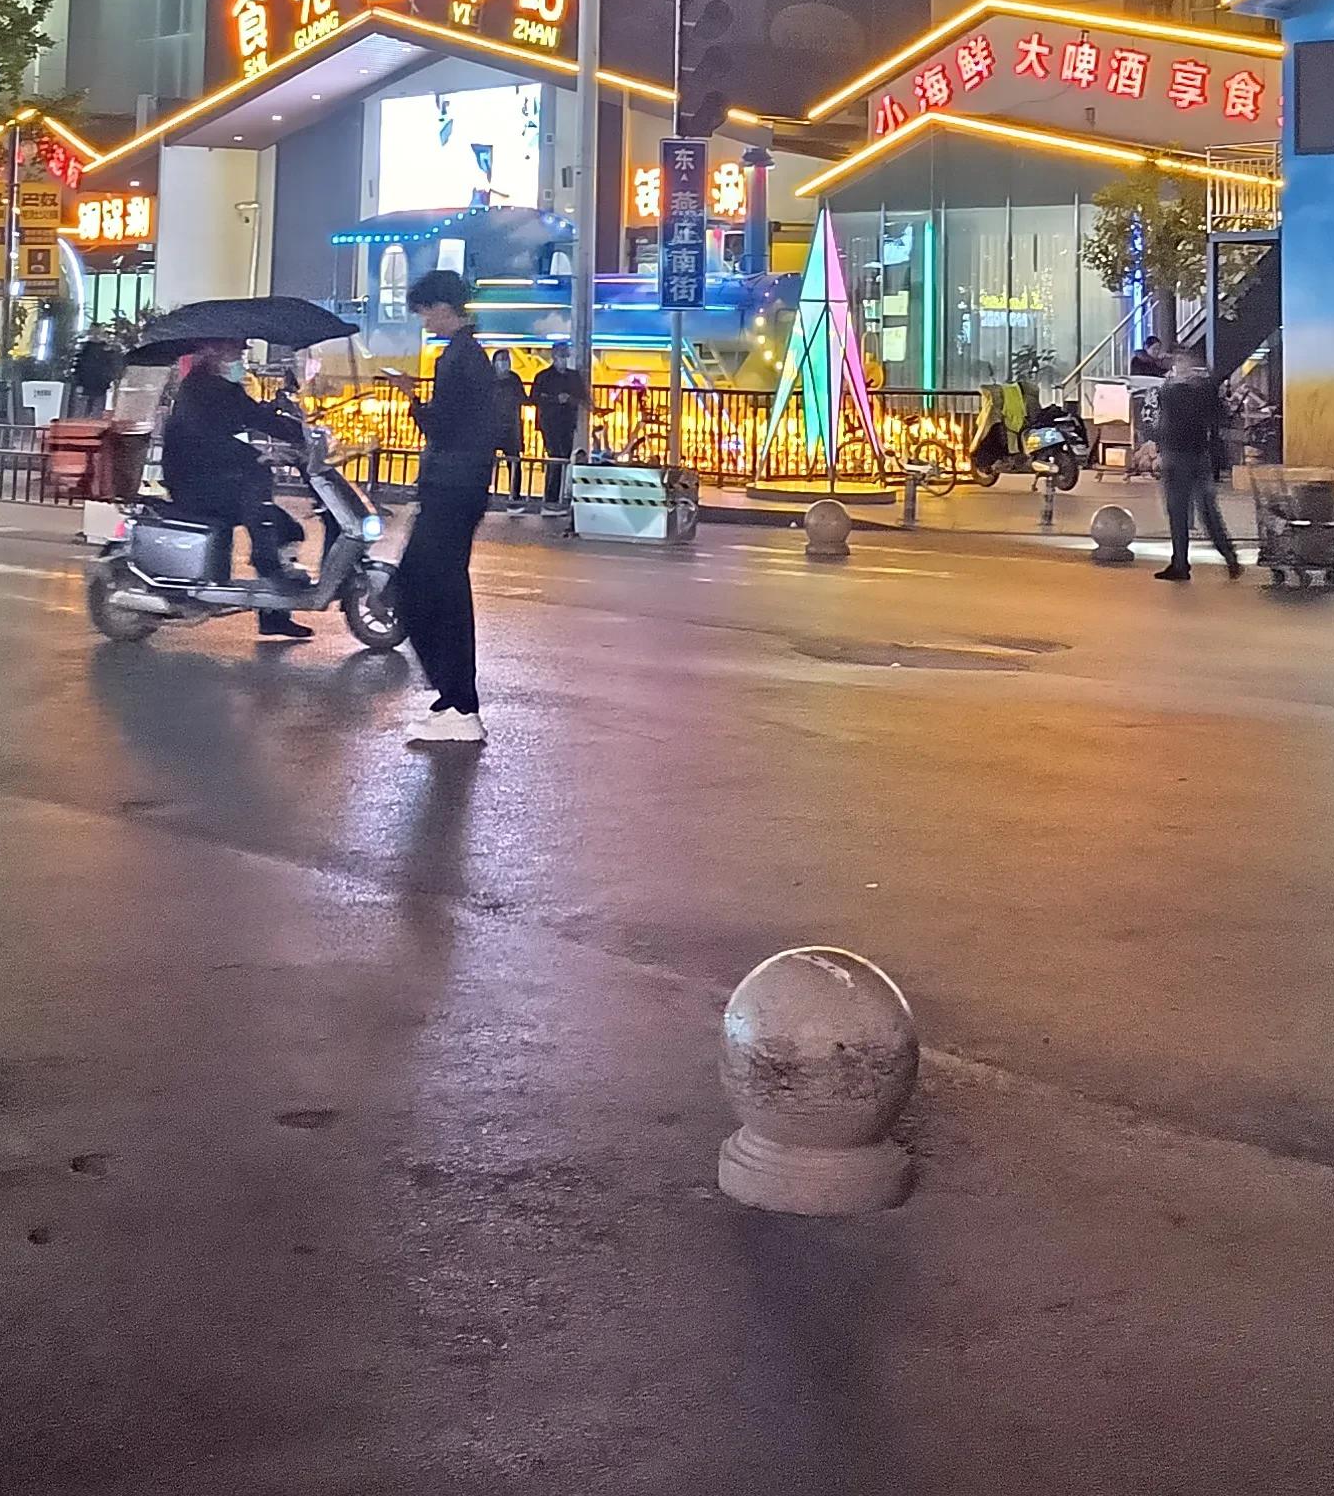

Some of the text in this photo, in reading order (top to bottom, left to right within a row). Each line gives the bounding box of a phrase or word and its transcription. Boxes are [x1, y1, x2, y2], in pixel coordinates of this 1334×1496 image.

[294, 11, 340, 50] GUANG
[453, 1, 472, 26] YI
[512, 18, 558, 49] ZHAN
[875, 35, 997, 137] 小海鲜
[1014, 33, 1152, 99] 大啤酒
[674, 148, 695, 170] 东
[21, 192, 59, 208] 巴奴
[669, 191, 703, 302] 燕庄南街
